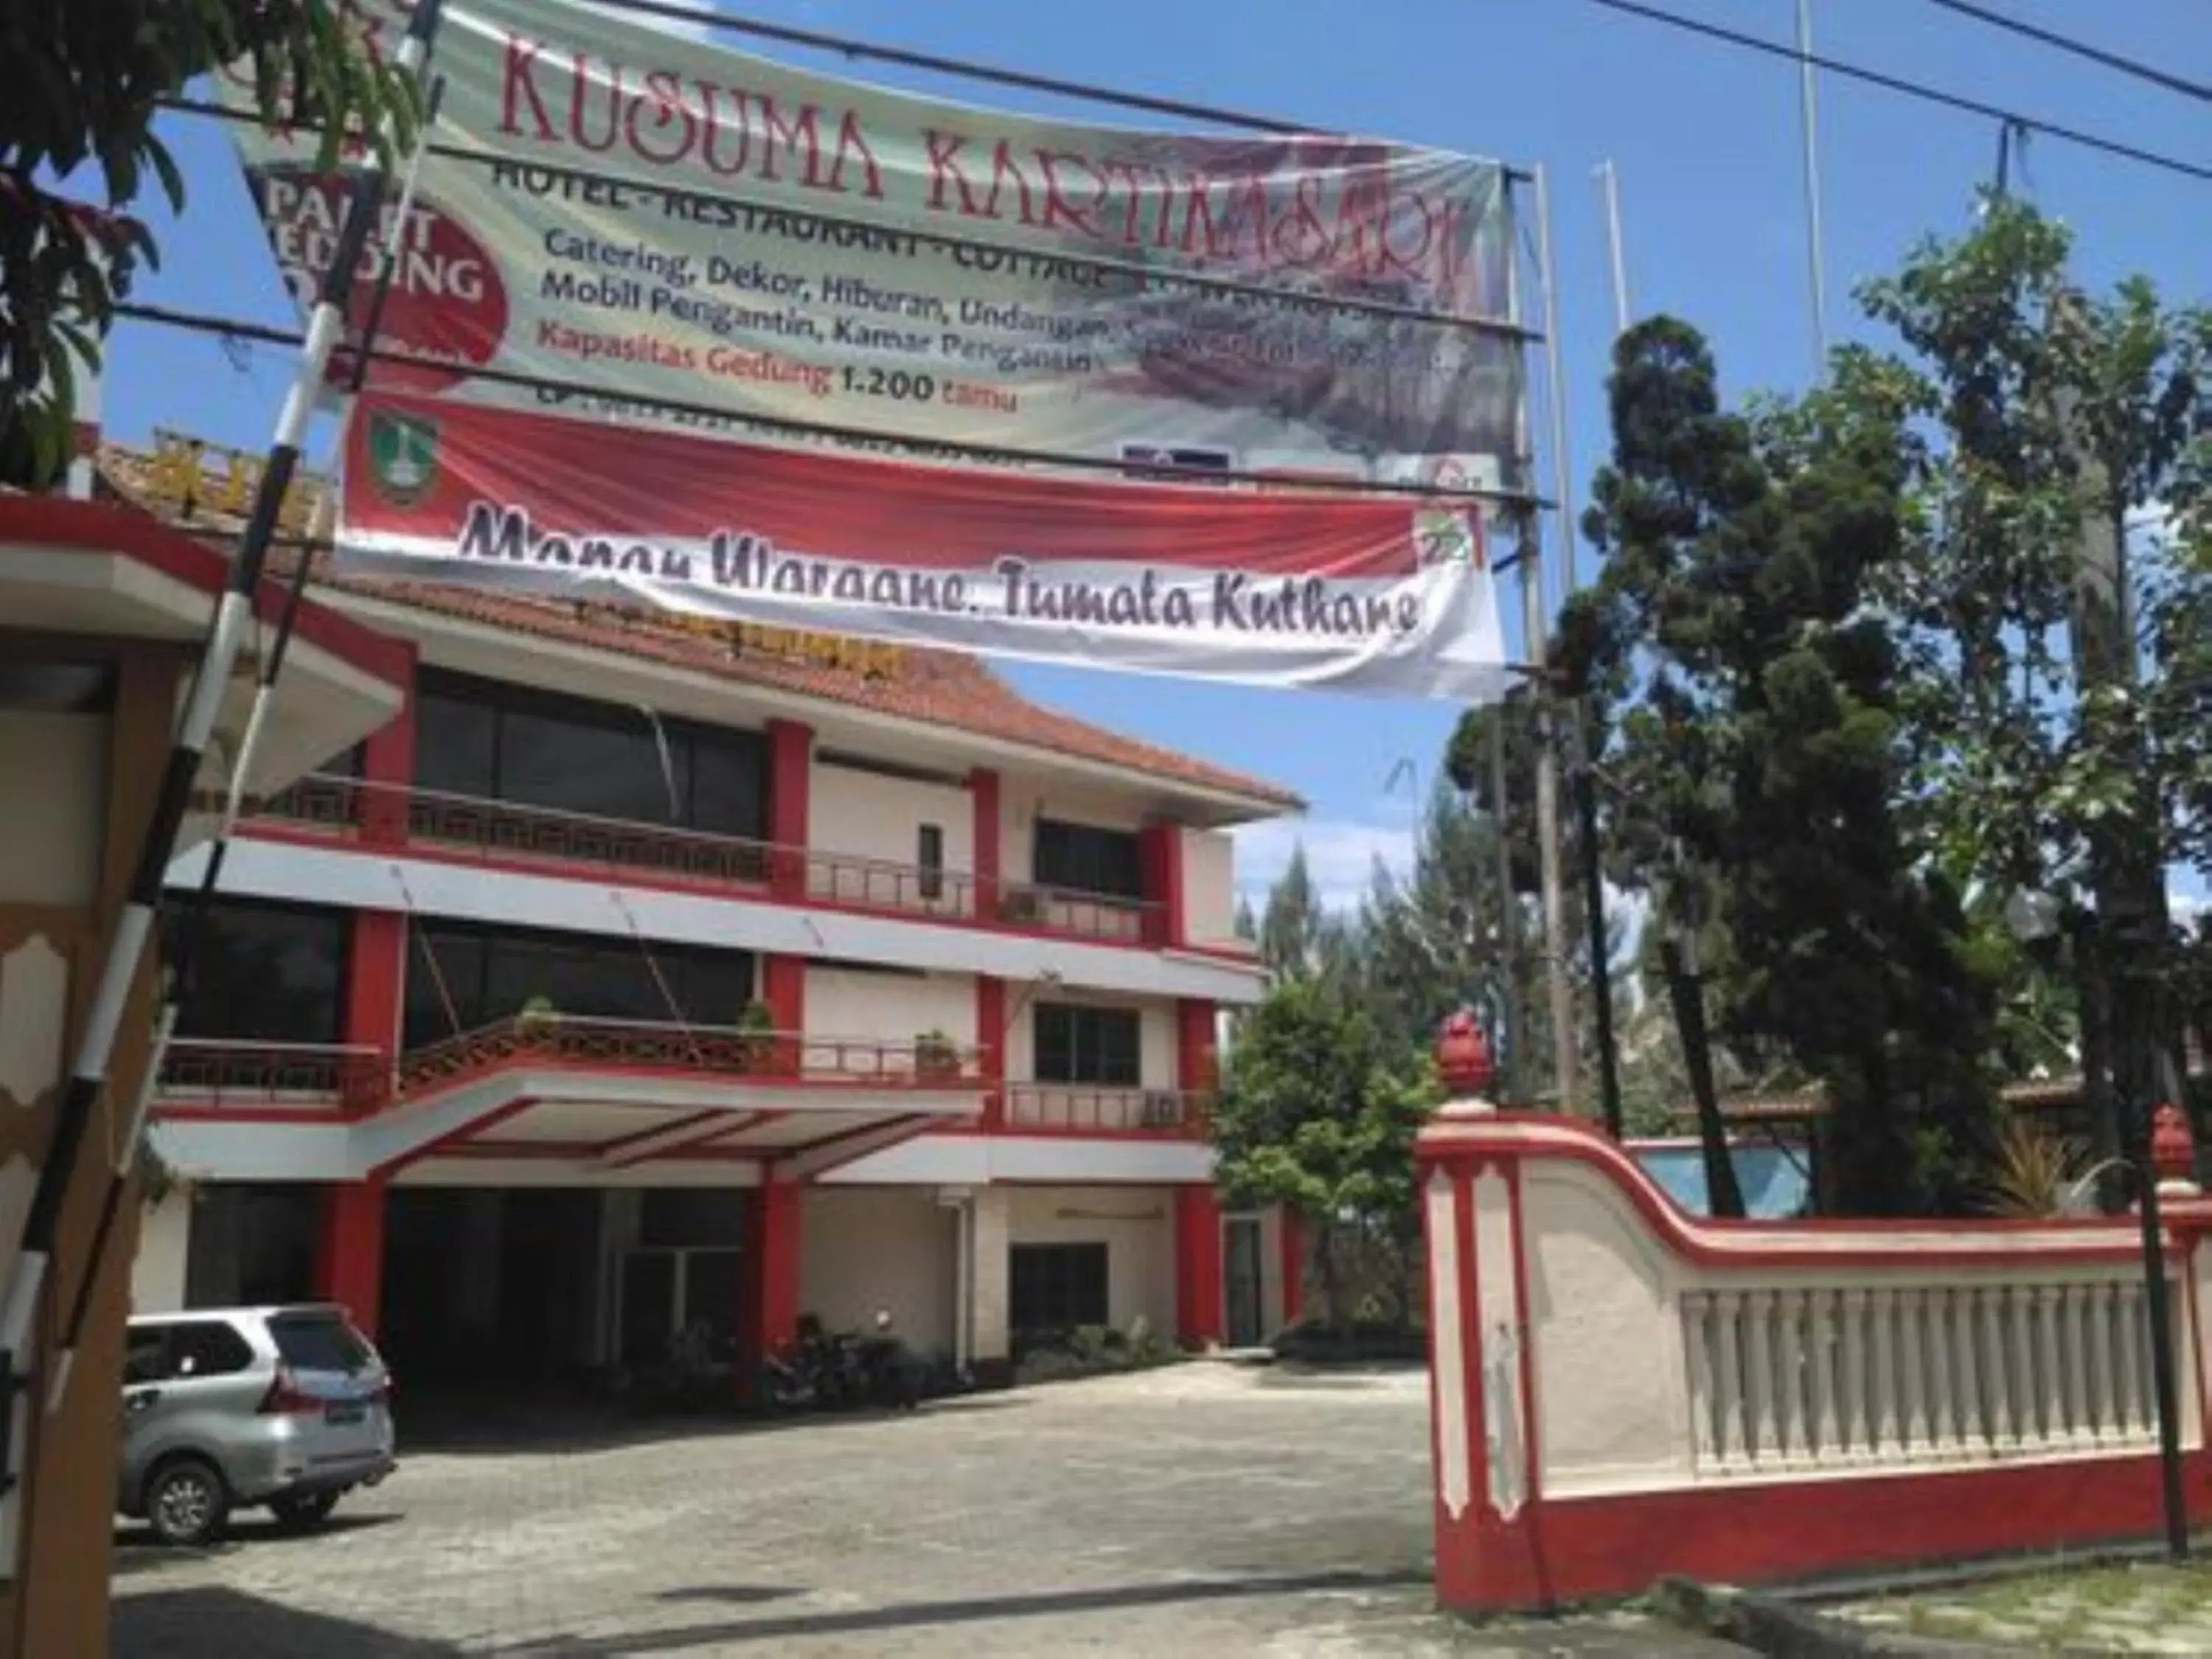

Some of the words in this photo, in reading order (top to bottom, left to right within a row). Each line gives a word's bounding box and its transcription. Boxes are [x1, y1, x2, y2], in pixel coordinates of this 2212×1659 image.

[497, 32, 883, 199] KUSUMA
[540, 270, 641, 310] Mobil
[650, 286, 826, 344] Pengantin,
[833, 316, 932, 354] Kamar
[544, 227, 698, 287] Catering,
[706, 255, 811, 303] Dekor,
[821, 273, 951, 327] Hiburan,
[535, 319, 697, 369] Kapasitas
[706, 345, 834, 400] Gedung
[842, 364, 934, 401] 1.200
[942, 378, 1018, 414] tamu
[997, 557, 1196, 630] Tumata
[1212, 571, 1420, 636] Kuthane
